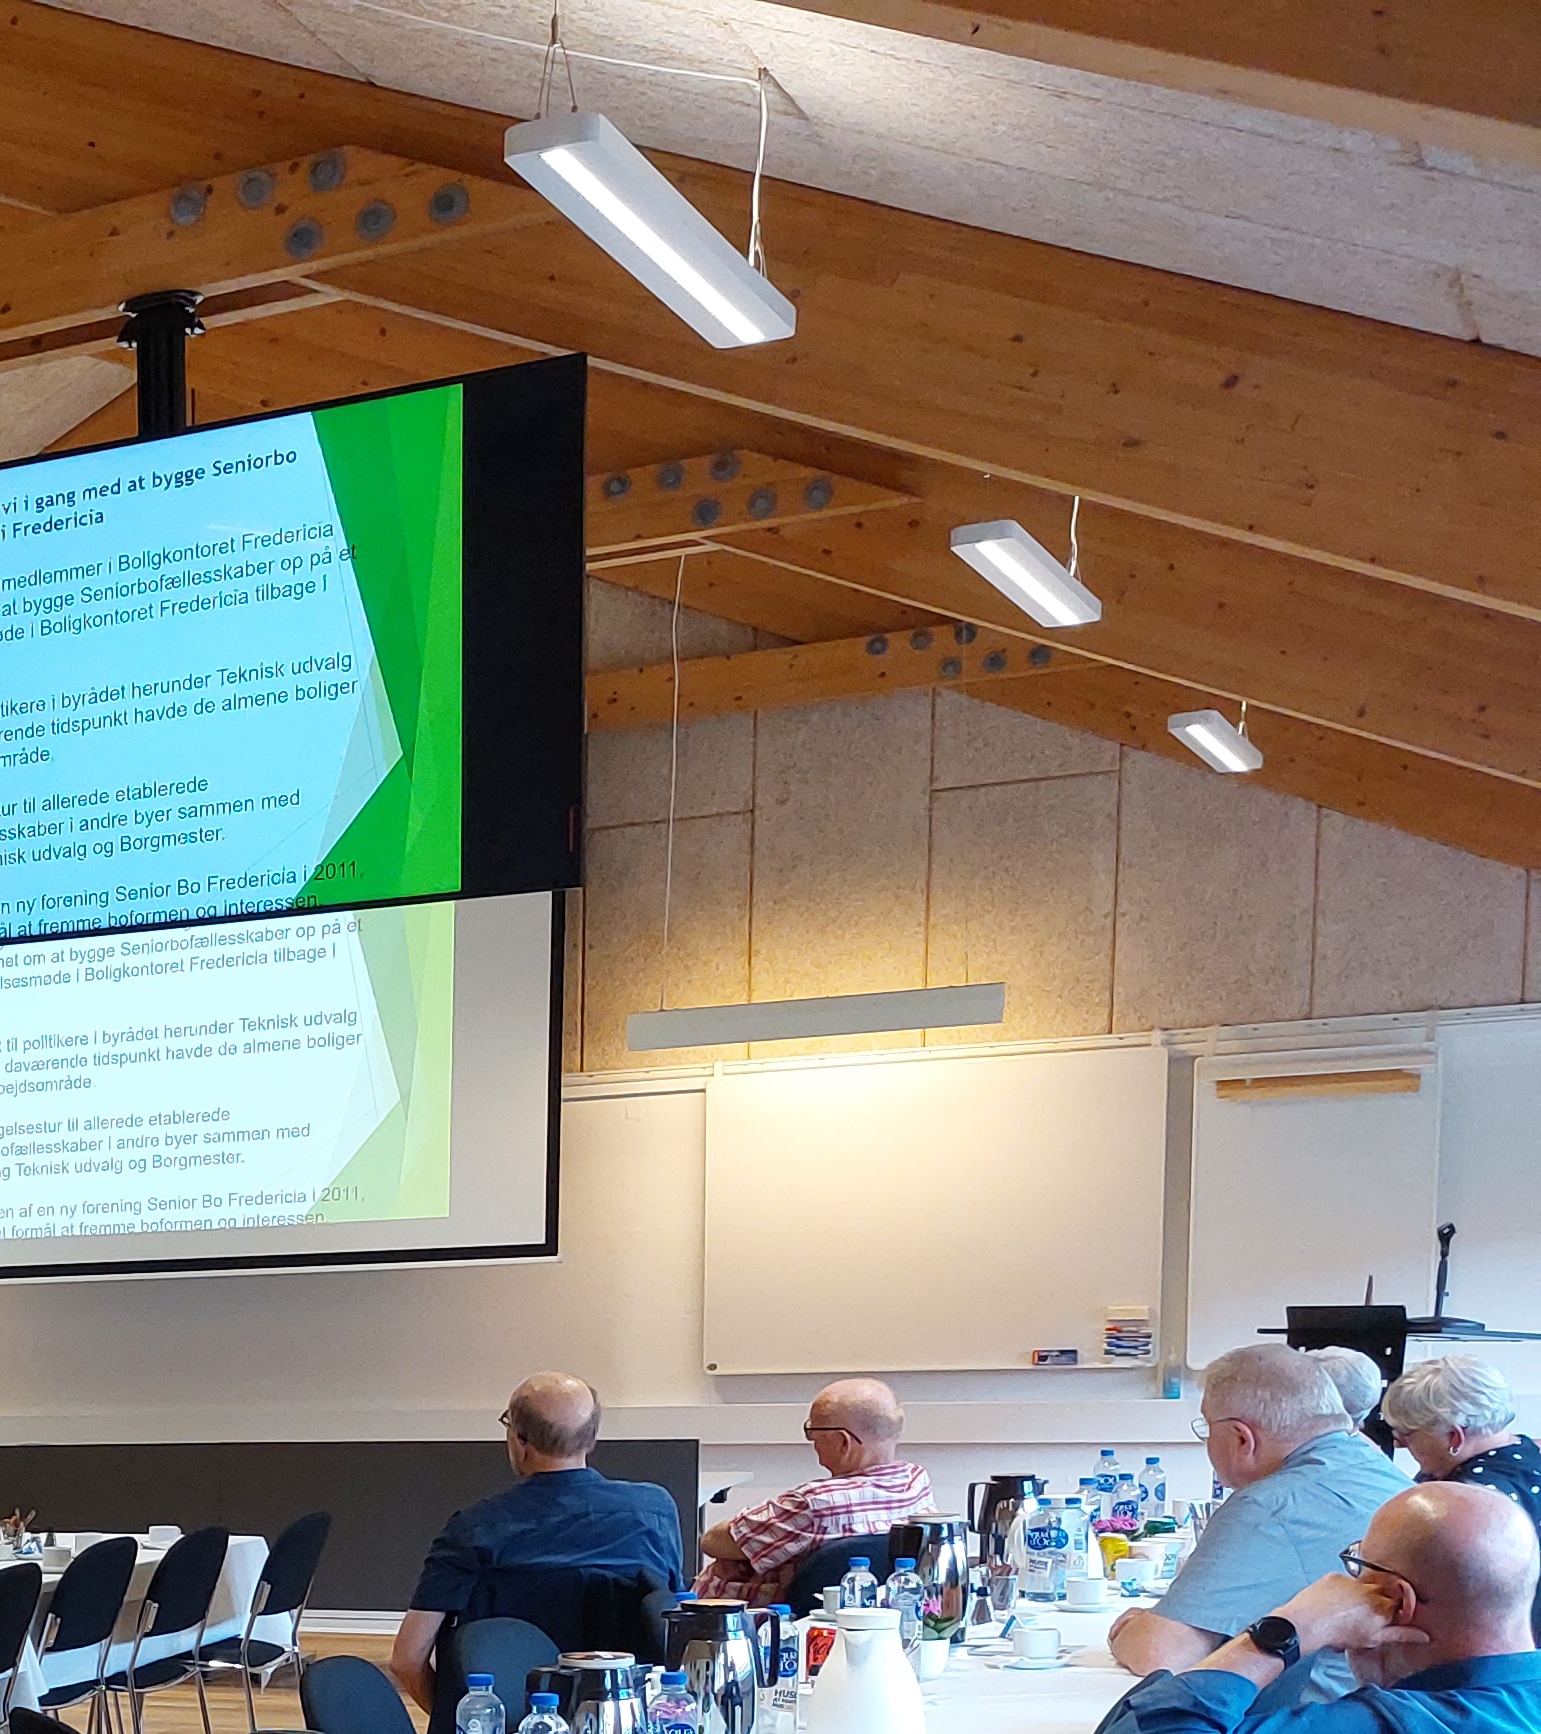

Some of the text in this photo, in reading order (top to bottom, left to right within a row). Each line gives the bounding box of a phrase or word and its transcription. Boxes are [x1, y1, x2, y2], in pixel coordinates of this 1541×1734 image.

[1, 498, 17, 516] vi
[23, 496, 28, 512] i
[34, 492, 75, 514] gang
[82, 480, 120, 501] med
[127, 476, 145, 493] at
[152, 469, 205, 492] bygge
[212, 450, 296, 478] Seniorbo
[0, 525, 6, 542] i
[12, 511, 103, 540] Fredericia
[108, 558, 111, 574] i
[118, 539, 235, 572] Boligkontoret
[242, 524, 333, 552] Fredericia
[1, 599, 18, 616] at
[22, 593, 74, 616] bygge
[80, 561, 275, 604] Seniorbofællesskaber
[280, 557, 303, 574] op
[310, 548, 331, 571] på
[339, 545, 357, 562] et
[30, 621, 33, 637] i
[40, 603, 154, 635] Boligkontoret
[160, 589, 248, 616] Fredericia
[254, 581, 316, 602] tilbage
[322, 575, 326, 591] i
[51, 695, 55, 711] i
[61, 686, 126, 713] byrådet
[131, 676, 212, 700] herunder
[220, 663, 285, 687] Teknisk
[291, 655, 352, 678] udvalg
[50, 710, 128, 735] tidspunkt
[134, 703, 187, 724] havde
[193, 699, 215, 716] de
[221, 692, 288, 712] almene
[295, 682, 357, 702] boliger
[23, 796, 35, 813] til
[41, 788, 109, 811] allerede
[115, 776, 208, 801] etablerede
[69, 816, 73, 832] i
[78, 812, 127, 831] andre
[134, 808, 172, 827] byer
[177, 798, 254, 819] sammen
[261, 789, 299, 809] med
[31, 841, 86, 862] udvalg
[92, 841, 113, 858] og
[16, 897, 37, 914] ny
[41, 888, 109, 908] forening
[115, 882, 171, 901] Senior
[177, 878, 200, 895] Bo
[207, 868, 296, 892] Fredericia
[303, 866, 307, 882] i
[23, 954, 45, 966] om
[50, 949, 64, 963] at
[69, 946, 115, 964] bygge
[120, 926, 291, 955] Seniorbofællesskaber
[295, 925, 315, 940] op
[321, 919, 341, 938] på
[346, 917, 363, 931] et
[76, 968, 79, 982] i
[84, 959, 185, 982] Boligkontoret
[189, 951, 267, 970] Fredericia
[273, 947, 326, 963] tilbage
[332, 943, 335, 957] i
[4, 1054, 87, 1073] daværende
[92, 1048, 161, 1068] tidspunkt
[165, 1044, 212, 1060] havde
[217, 1042, 237, 1056] de
[242, 1040, 301, 1054] almene
[307, 1034, 363, 1051] boliger
[6, 1038, 17, 1052] til
[22, 1034, 88, 1054] politikere
[94, 1031, 97, 1045] i
[102, 1027, 159, 1047] byrådet
[164, 1021, 234, 1039] herunder
[238, 1015, 298, 1033] Teknisk
[303, 1011, 357, 1028] udvalg
[67, 1118, 78, 1132] til
[83, 1114, 143, 1130] allerede
[148, 1108, 230, 1126] etablerede
[108, 1136, 111, 1149] i
[116, 1134, 159, 1149] andre
[164, 1132, 198, 1149] byer
[202, 1129, 270, 1143] sammen
[276, 1123, 310, 1138] med
[14, 1160, 69, 1176] Teknisk
[74, 1157, 122, 1174] udvalg
[128, 1158, 146, 1173] og
[18, 1203, 33, 1217] af
[36, 1205, 54, 1216] en
[60, 1204, 77, 1219] ny
[82, 1198, 141, 1215] forening
[147, 1195, 198, 1210] Senior
[202, 1194, 222, 1207] Bo
[228, 1189, 306, 1206] Fredericia
[312, 1188, 315, 1202] i
